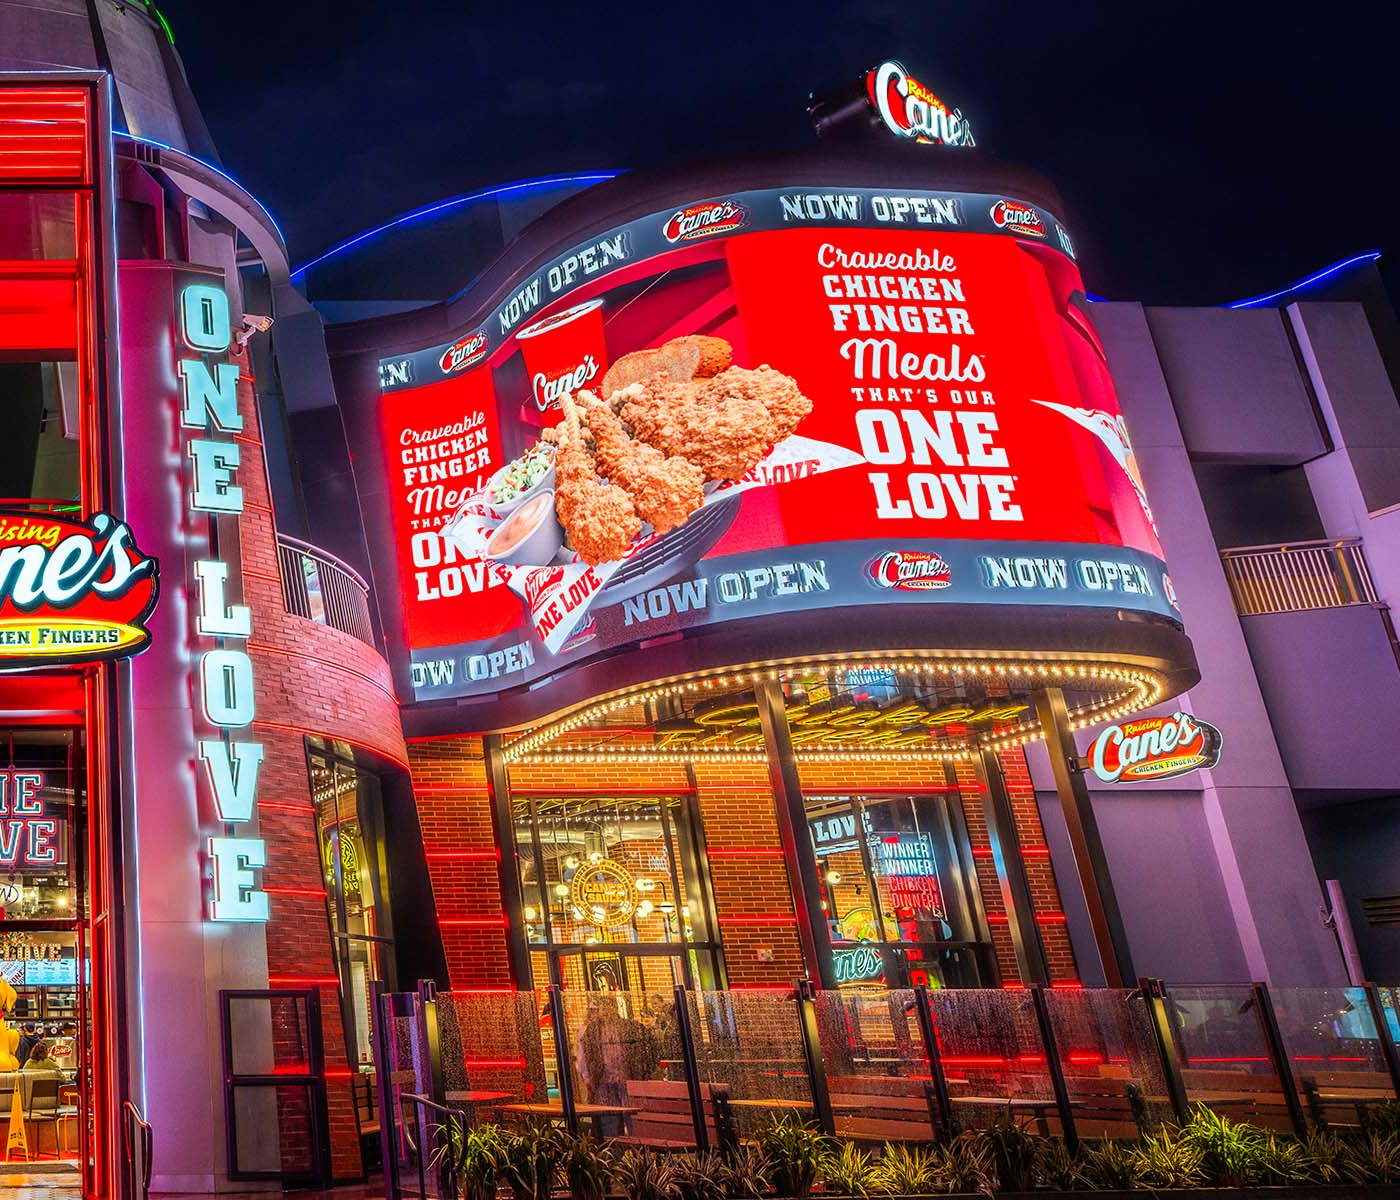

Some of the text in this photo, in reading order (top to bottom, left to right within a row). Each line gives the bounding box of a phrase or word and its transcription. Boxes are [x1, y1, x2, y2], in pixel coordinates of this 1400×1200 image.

[907, 80, 946, 113] Raising
[663, 201, 738, 243] Cane's
[780, 196, 957, 224] NOW OPEN
[818, 243, 957, 272] Craveable
[499, 235, 625, 335] NOW OPEN
[822, 275, 966, 301] CHICKEN
[829, 304, 975, 334] FINGER
[440, 333, 486, 373] Cane's
[533, 354, 600, 412] Cane's
[851, 387, 995, 405] THAT'S OUR
[400, 411, 485, 446] Craveable
[401, 427, 489, 465] CHICKEN
[855, 409, 1009, 467] ONE
[403, 447, 492, 486] FINGER
[868, 472, 1024, 521] LOVE
[411, 514, 450, 529] THAT
[879, 551, 951, 588] Cane's
[986, 557, 1067, 589] NOW
[1081, 560, 1154, 597] OPEN
[178, 284, 269, 922] ONE LOVE
[623, 578, 708, 627] NOW
[720, 560, 831, 604] OPEN
[38, 627, 120, 644] FINGERS
[410, 640, 536, 687] OW OPEN
[1124, 720, 1162, 736] Raising
[1094, 711, 1202, 783] Cane's
[882, 842, 930, 858] WINNER
[885, 859, 934, 875] WINNER
[889, 876, 938, 892] CHICKEN
[892, 892, 941, 908] DINNER!
